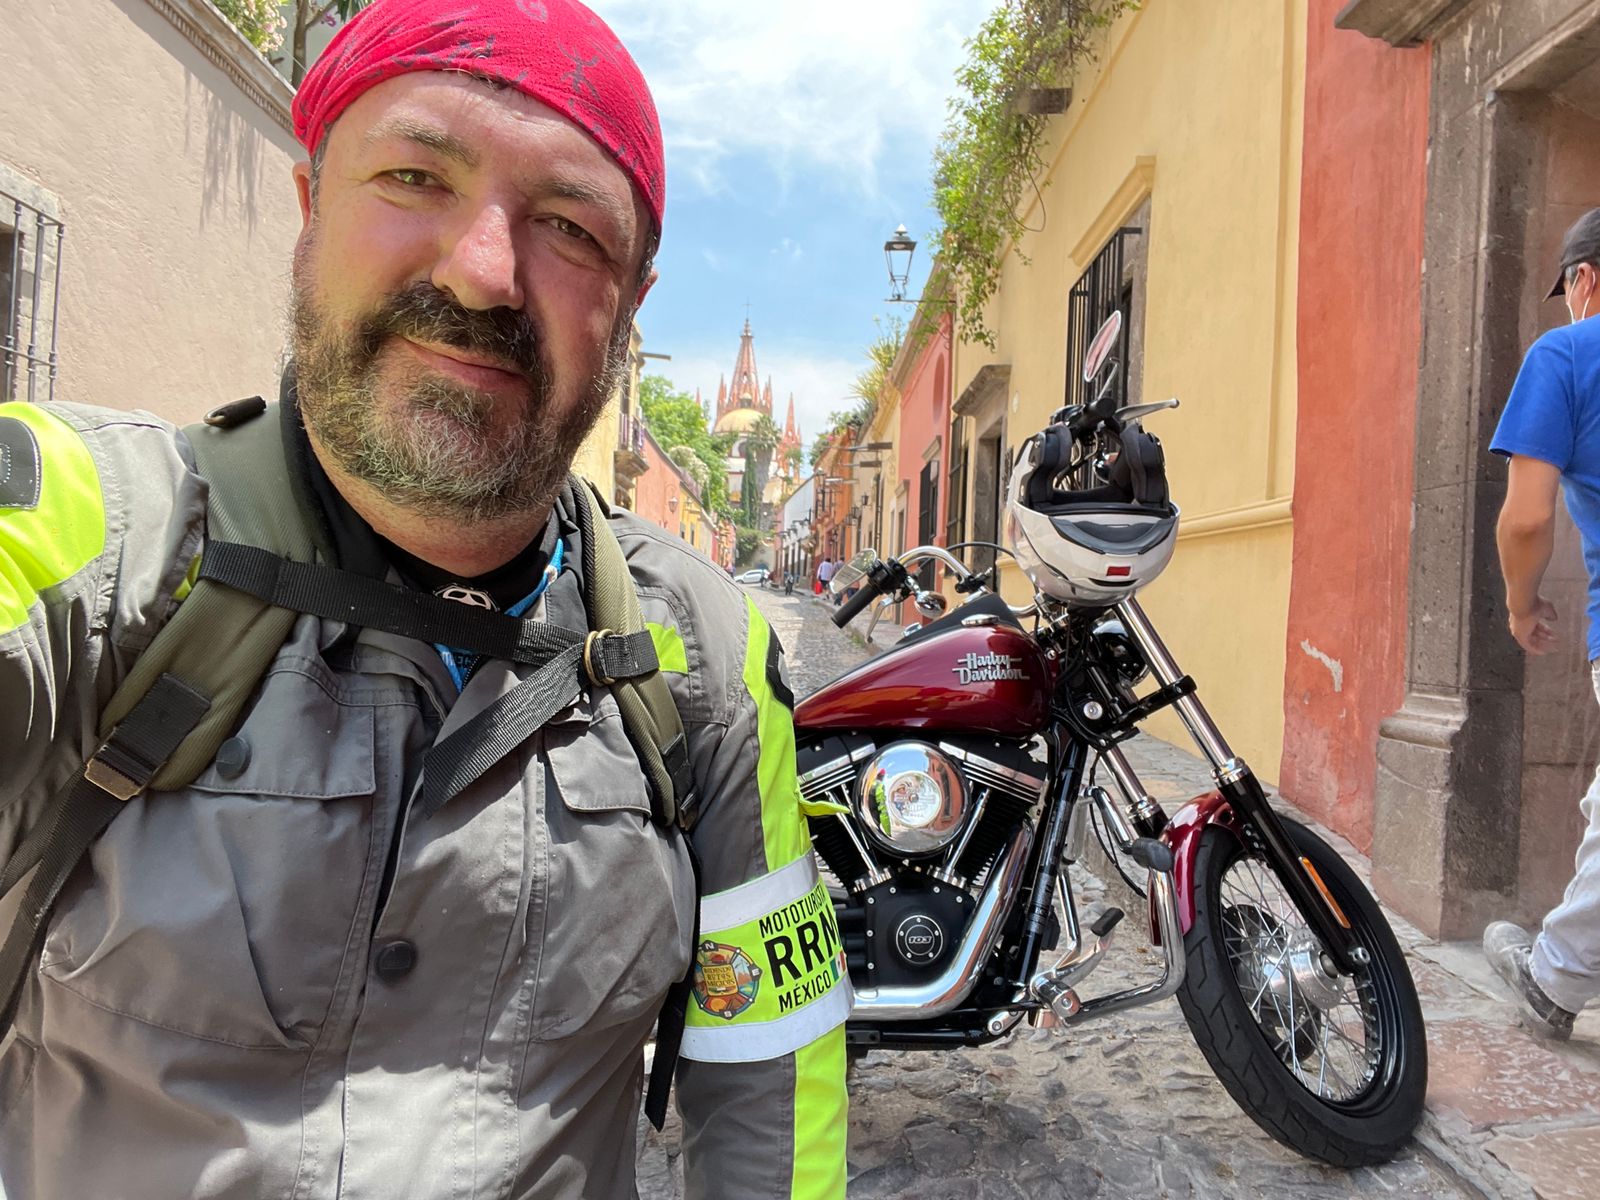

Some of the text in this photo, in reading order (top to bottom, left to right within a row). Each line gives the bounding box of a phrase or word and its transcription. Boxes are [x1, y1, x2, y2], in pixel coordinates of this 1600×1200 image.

[957, 651, 1022, 669] Harley
[952, 665, 1030, 685] Davidson
[764, 903, 840, 988] RRM
[908, 935, 932, 944] 103
[778, 969, 831, 1013] MÉXICO
